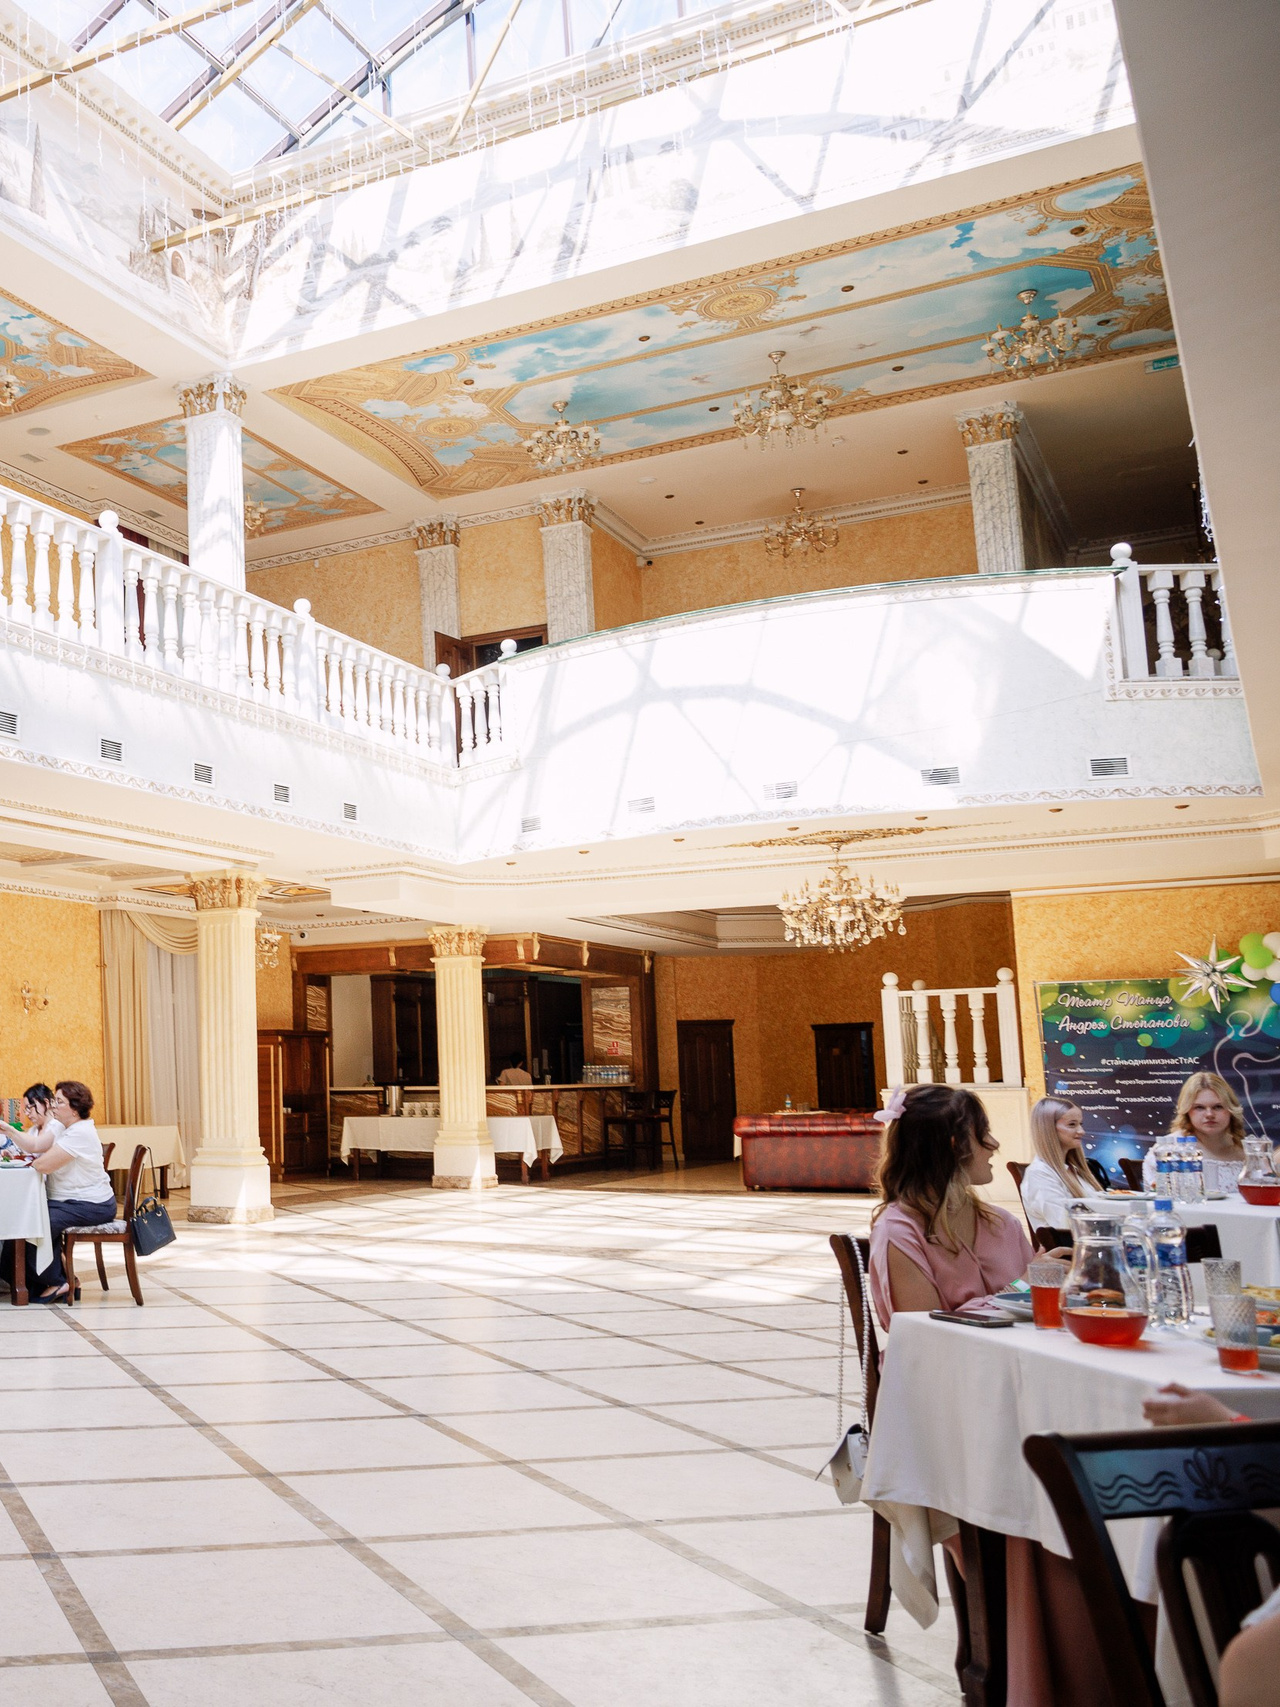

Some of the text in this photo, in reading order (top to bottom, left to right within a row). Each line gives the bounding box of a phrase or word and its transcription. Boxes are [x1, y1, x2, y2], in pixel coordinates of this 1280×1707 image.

[1057, 990, 1173, 1011] Театр Танца
[1058, 1014, 1190, 1034] Андрея Степанова
